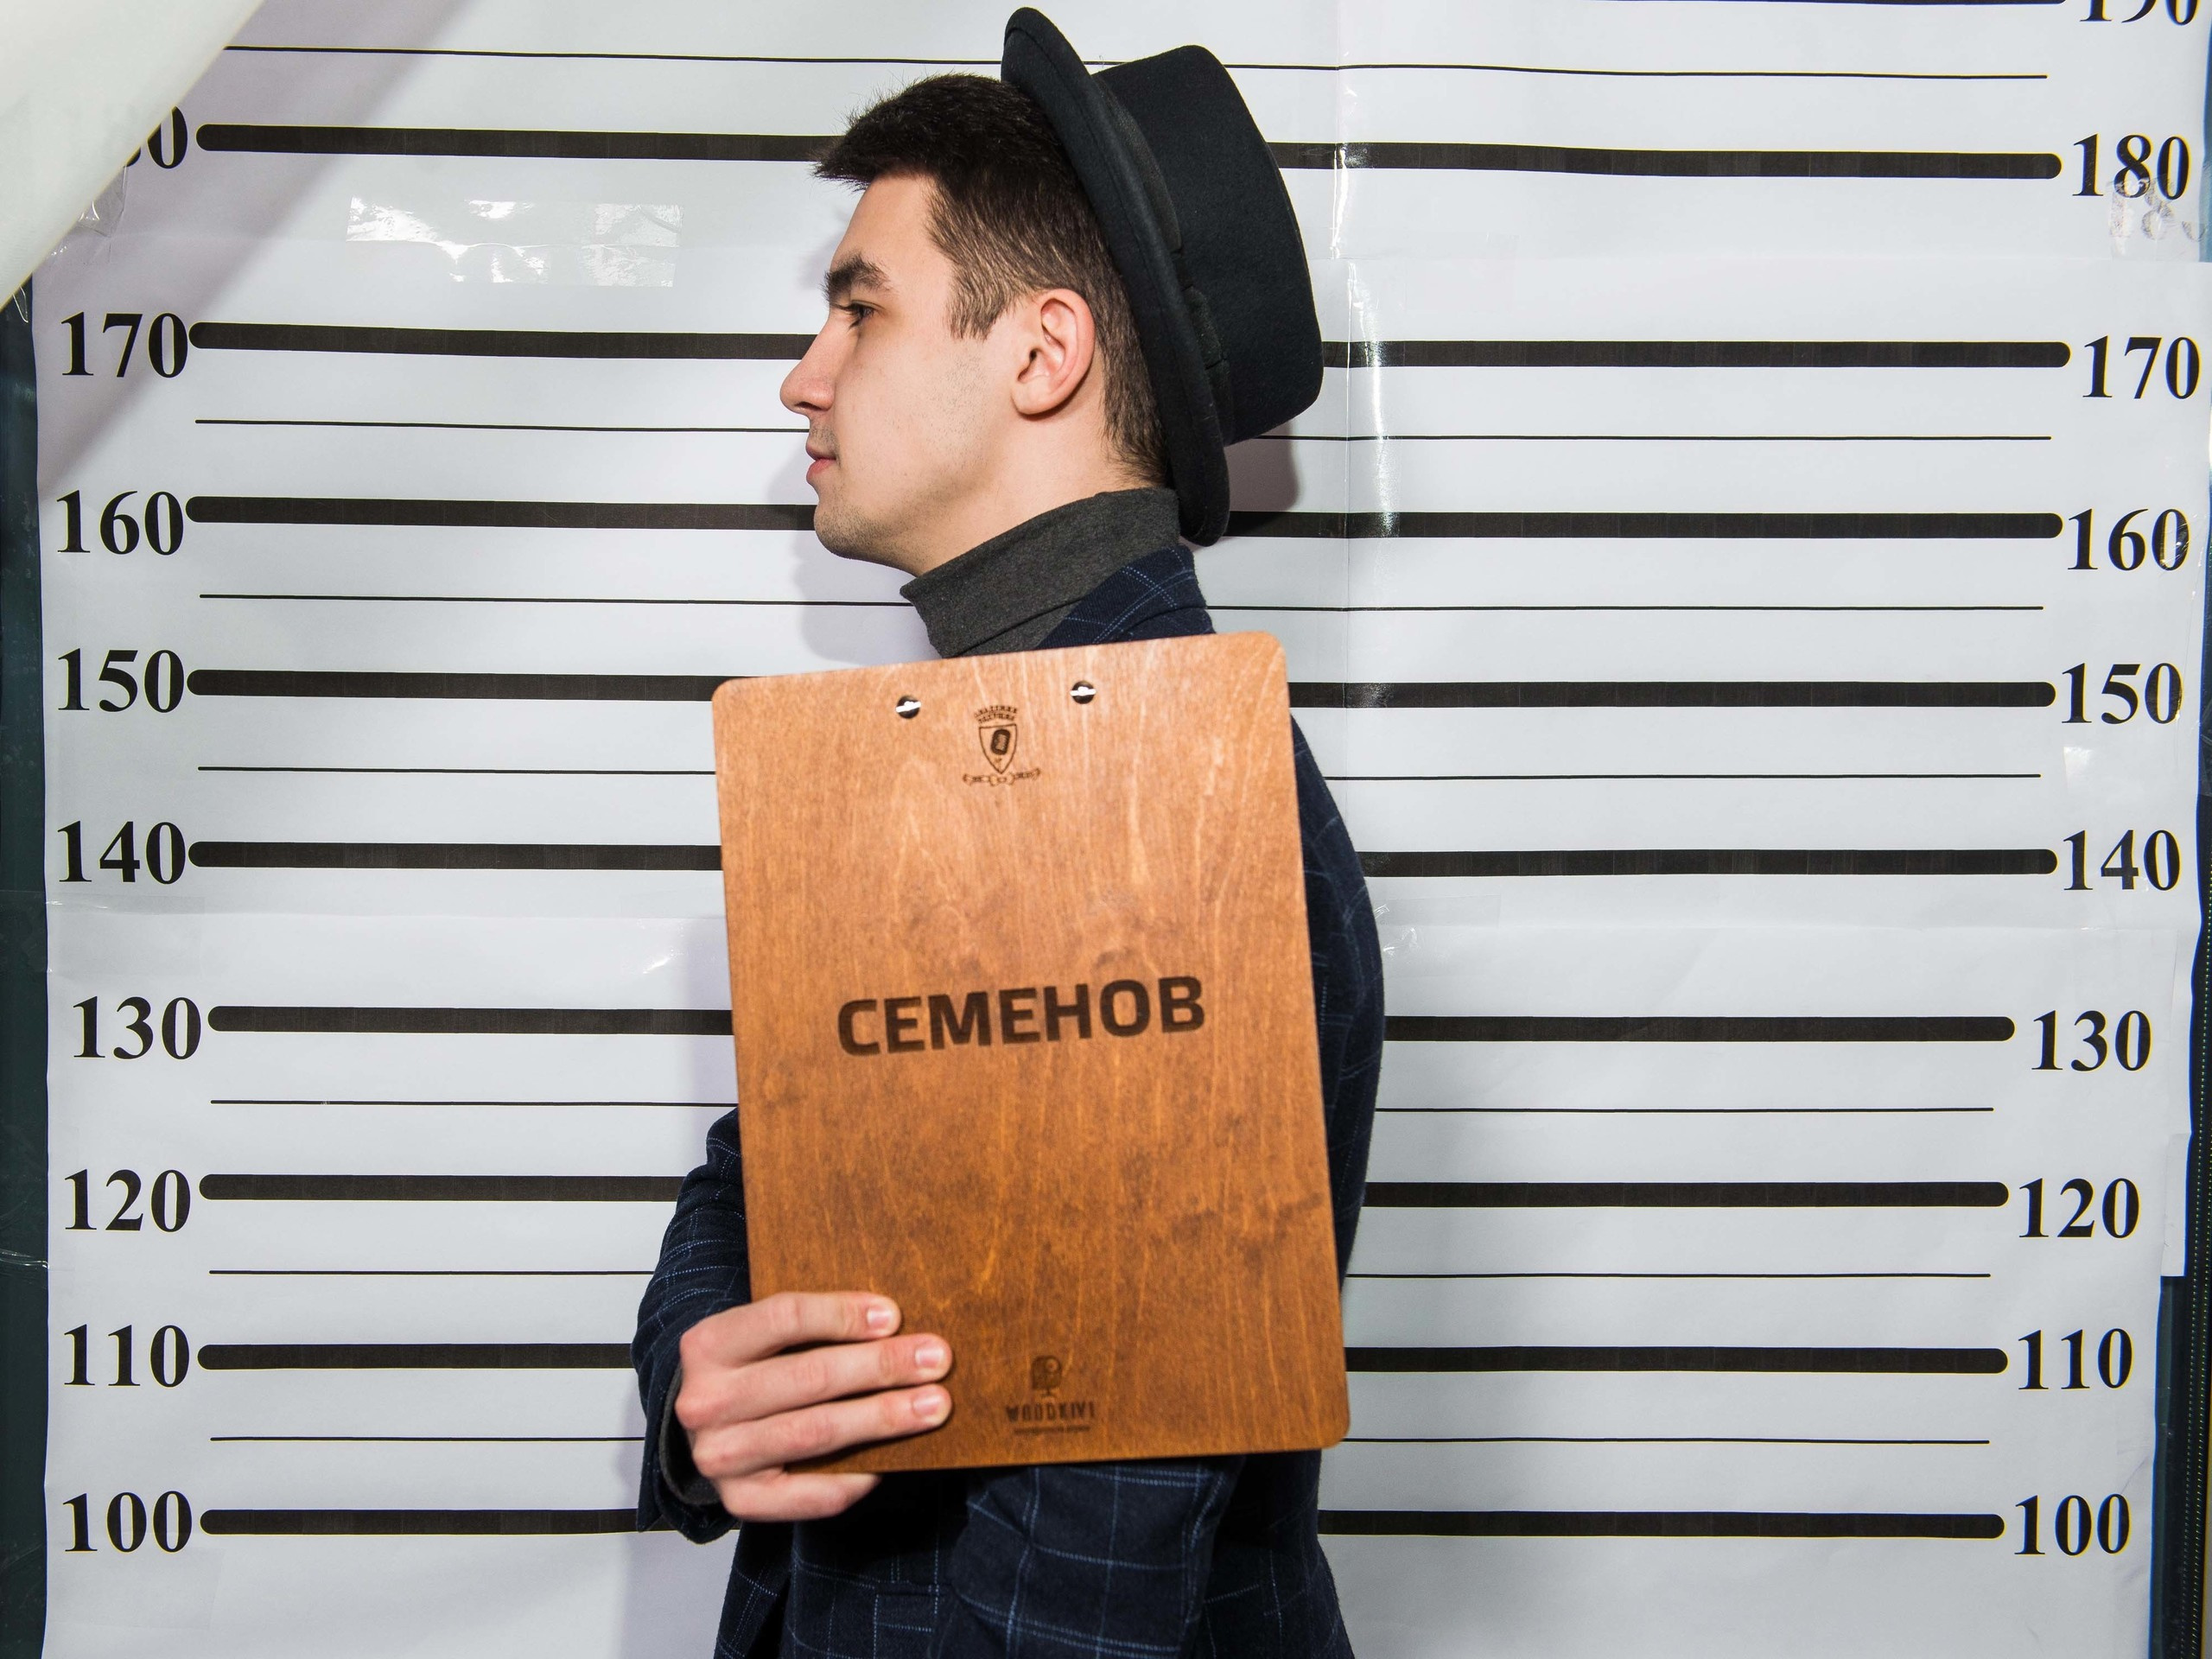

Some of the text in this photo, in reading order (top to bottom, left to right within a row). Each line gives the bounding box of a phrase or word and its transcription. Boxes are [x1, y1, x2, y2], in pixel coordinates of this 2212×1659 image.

[2073, 133, 2190, 200] 180
[60, 311, 188, 378] 170
[2082, 335, 2201, 399] 170
[56, 490, 184, 556] 160
[2068, 508, 2189, 571] 160
[58, 648, 184, 713] 150
[2062, 663, 2182, 724] 150
[57, 820, 186, 885] 140
[2063, 830, 2180, 891] 140
[73, 995, 201, 1060] 130
[838, 976, 1205, 1056] СЕМЕНОВ
[2031, 1010, 2151, 1071] 130
[64, 1169, 191, 1232] 120
[2018, 1178, 2139, 1238] 120
[64, 1324, 190, 1388] 110
[2018, 1328, 2133, 1390] 110
[62, 1491, 193, 1553] 100
[2014, 1493, 2130, 1556] 100
